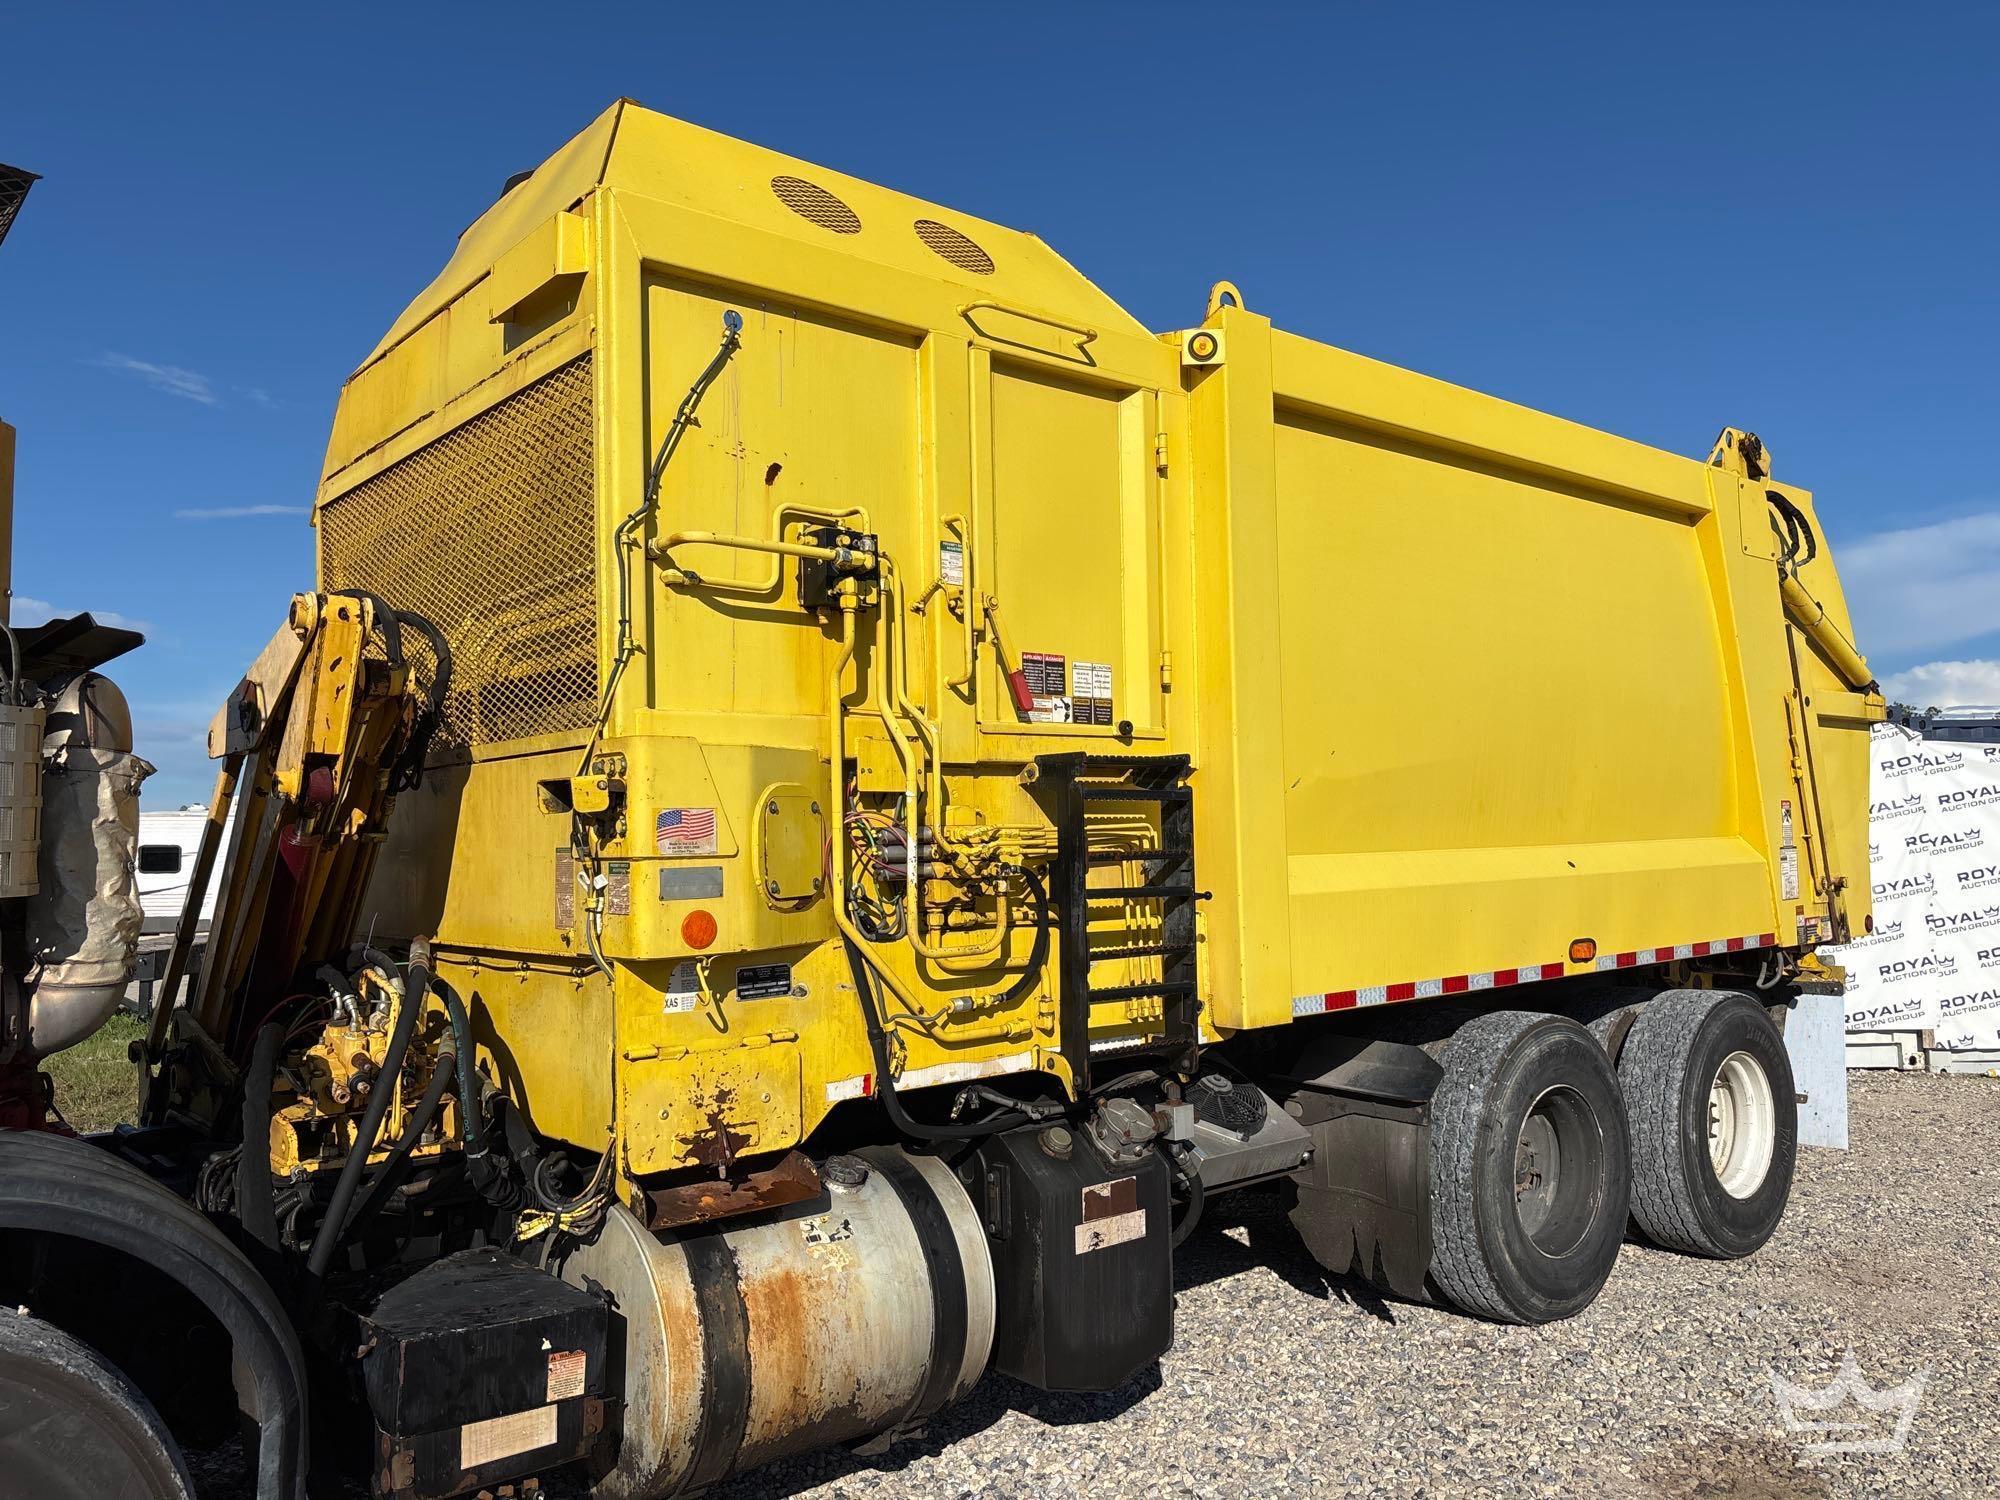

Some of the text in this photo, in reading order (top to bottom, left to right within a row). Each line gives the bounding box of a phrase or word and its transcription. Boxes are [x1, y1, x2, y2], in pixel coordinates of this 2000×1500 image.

[1881, 752, 1946, 772] ROYAL
[1929, 763, 1965, 775] GROUP
[1938, 785, 2000, 806] ROYAL
[1942, 799, 1987, 813] AUCTION
[1908, 840, 1984, 857] AUCION GROUP
[1872, 876, 1926, 895] OYAL
[1961, 876, 2000, 890] AUCTIO
[1928, 926, 1967, 937] ACTION
[1821, 933, 1905, 955] AUCTION GROUP
[1882, 969, 1928, 984] AUCTION
[1940, 989, 2000, 1010] ROYAL
[1942, 1003, 1987, 1018] AUCTION
[1846, 1011, 1926, 1030] UCTION GROUP
